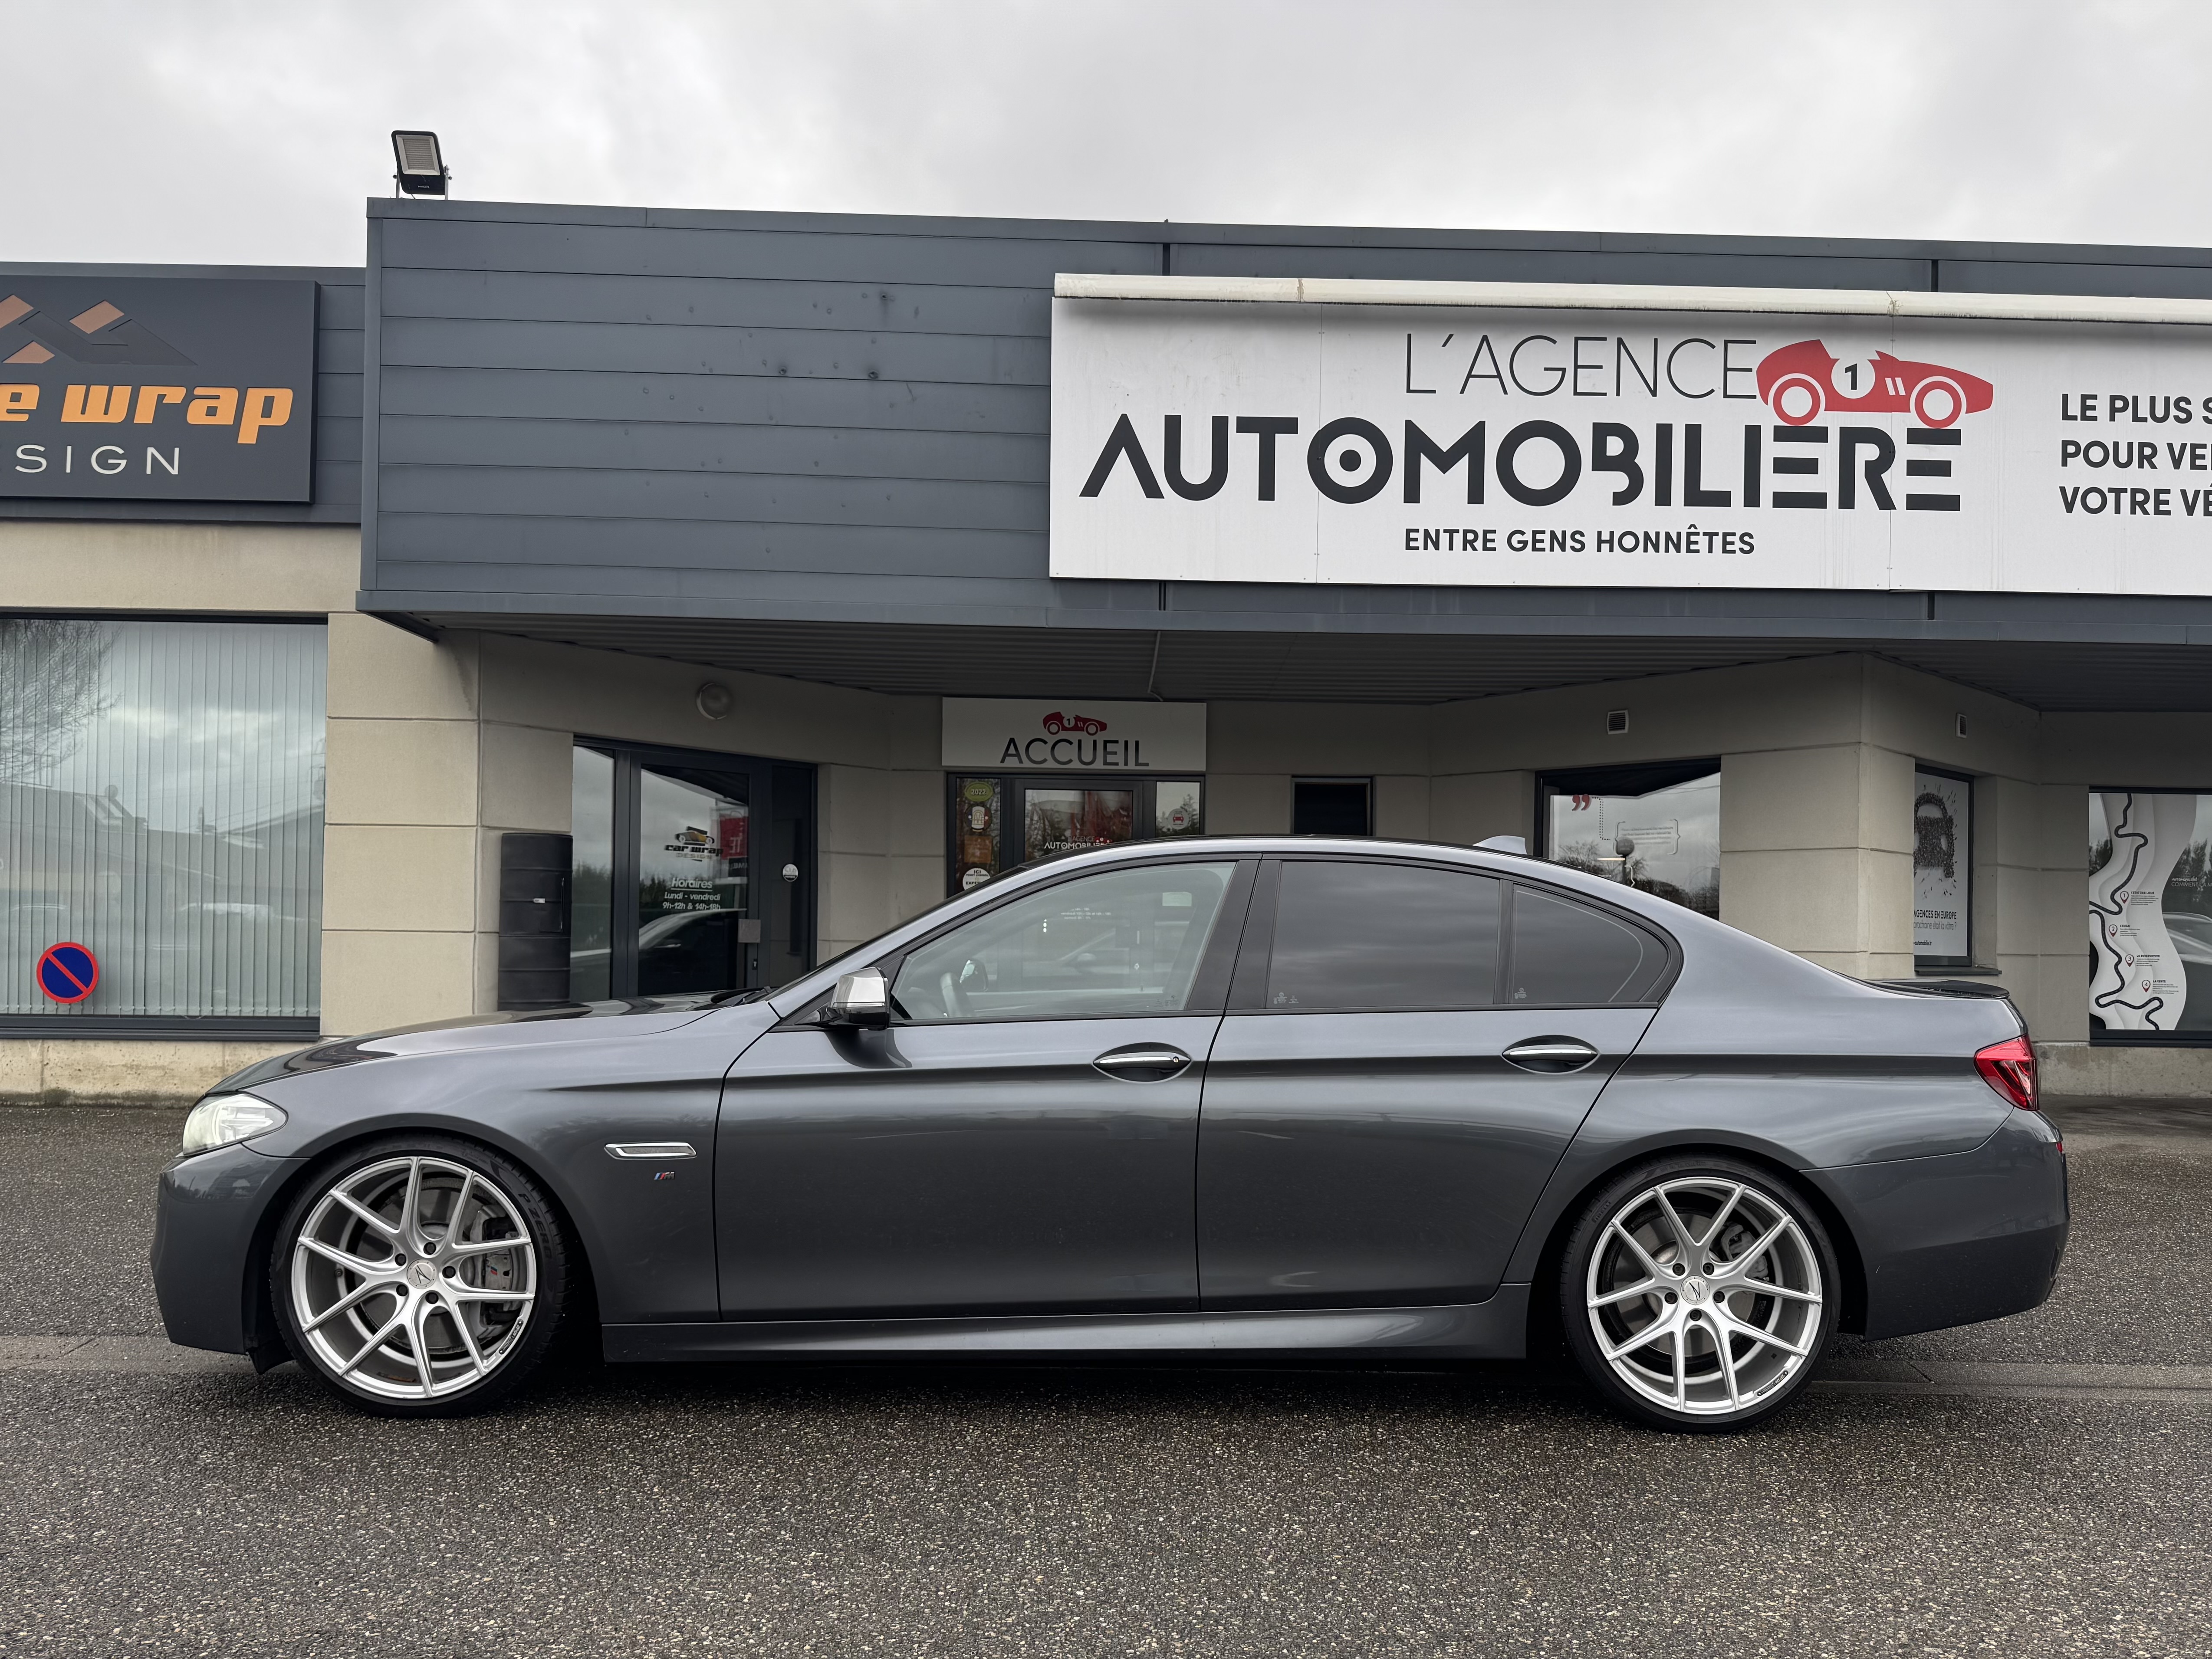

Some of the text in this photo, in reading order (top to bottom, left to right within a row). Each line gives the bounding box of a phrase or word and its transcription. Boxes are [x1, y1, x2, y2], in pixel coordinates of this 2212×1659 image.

[1405, 333, 1757, 399] L'AGENCE
[1844, 363, 1858, 390] 1
[61, 384, 293, 444] wrap
[2062, 394, 2097, 421] LE
[2109, 395, 2192, 424] PLUS
[15, 444, 180, 475] SIGN
[1079, 414, 1961, 511] AUTOMOBILIERE
[2061, 440, 2158, 469] POUR
[2059, 486, 2171, 516] VOTRE
[1405, 524, 1755, 555] ENTRE GENS HONNÊTES
[1000, 737, 1149, 767] ACCUEIL
[690, 846, 723, 857] wrap
[671, 877, 713, 889] Horaires
[1914, 910, 1956, 920] AGENCES EN EUROPE
